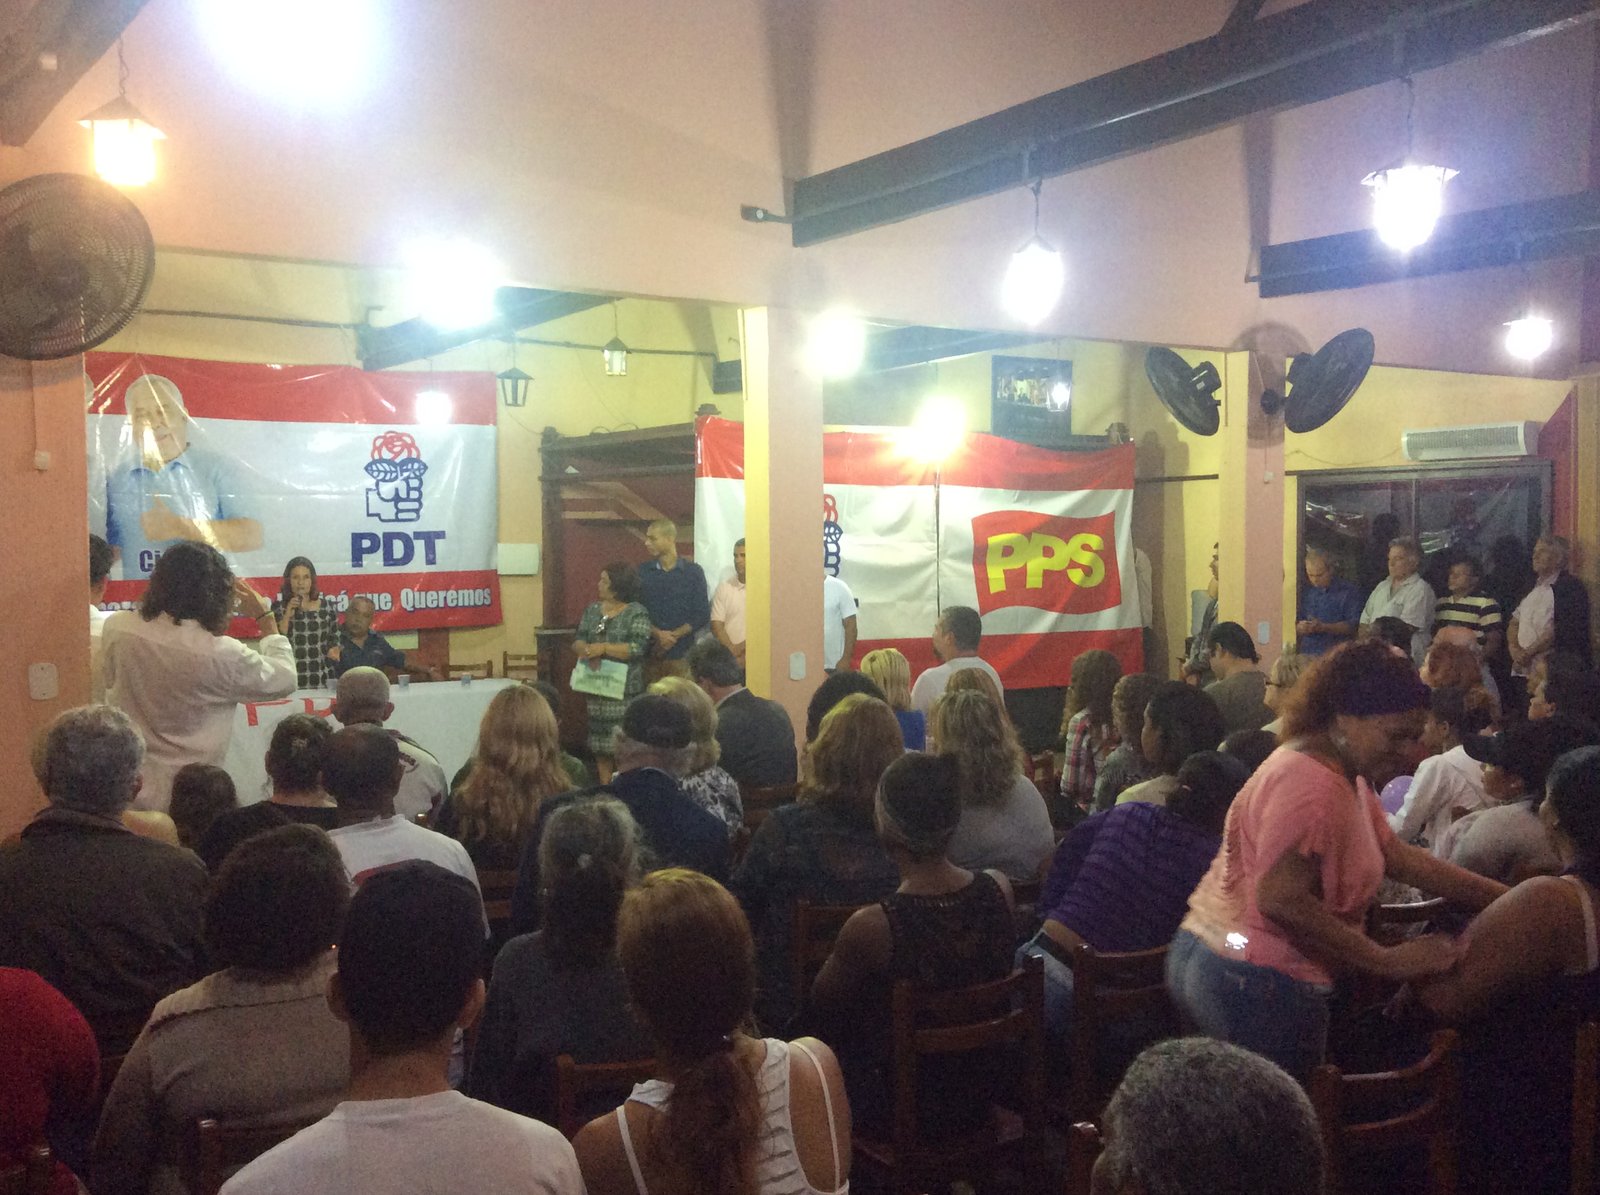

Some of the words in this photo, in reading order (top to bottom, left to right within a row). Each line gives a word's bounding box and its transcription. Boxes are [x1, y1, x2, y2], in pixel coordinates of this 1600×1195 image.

[350, 530, 446, 568] PDT
[986, 532, 1105, 594] PPS
[354, 592, 392, 611] ue
[400, 587, 492, 612] Queremos
